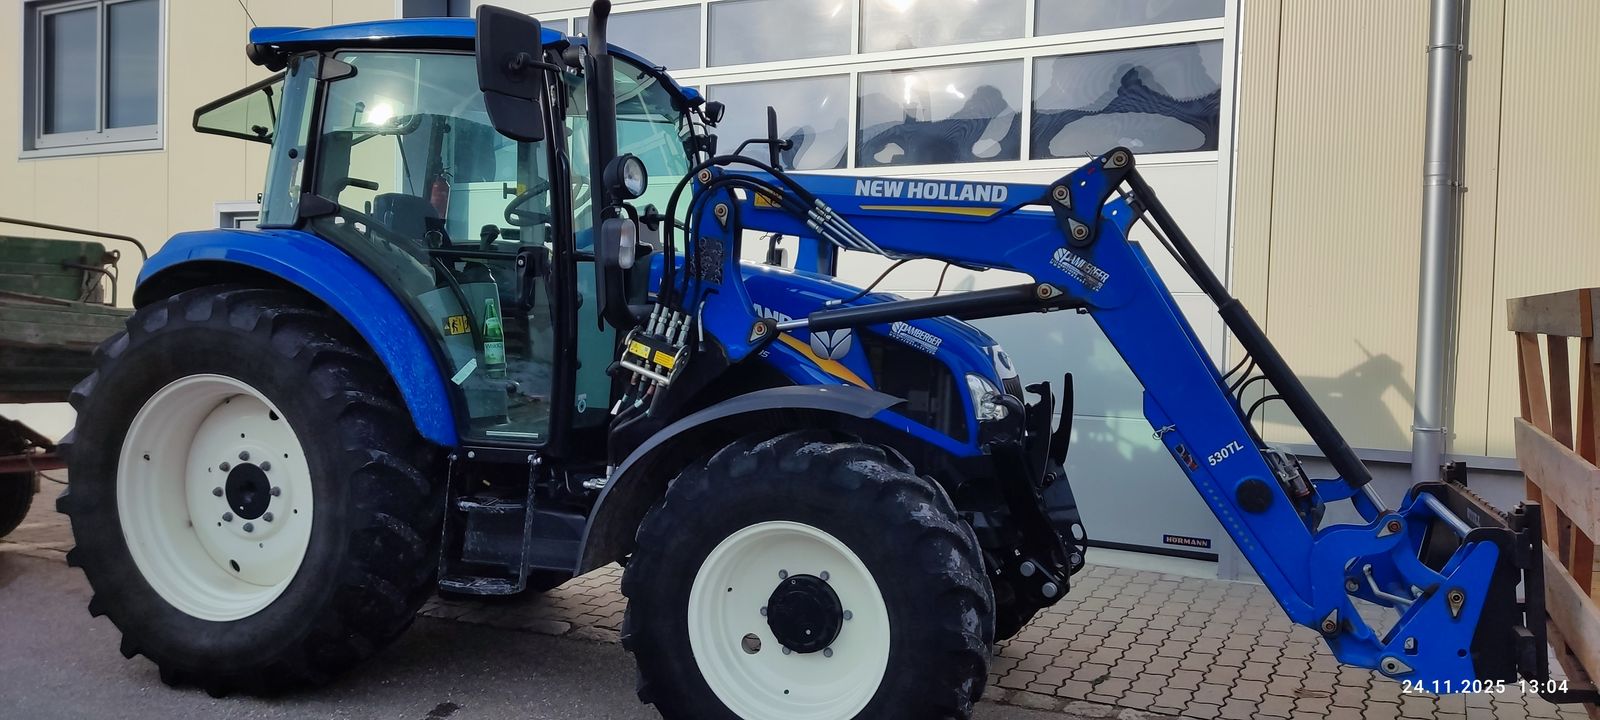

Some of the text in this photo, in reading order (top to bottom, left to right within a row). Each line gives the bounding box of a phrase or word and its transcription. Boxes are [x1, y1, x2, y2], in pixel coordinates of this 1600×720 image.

[855, 179, 1008, 203] NEW HOLLAND
[898, 322, 943, 347] PAMBERGER
[1207, 440, 1244, 467] 530TL
